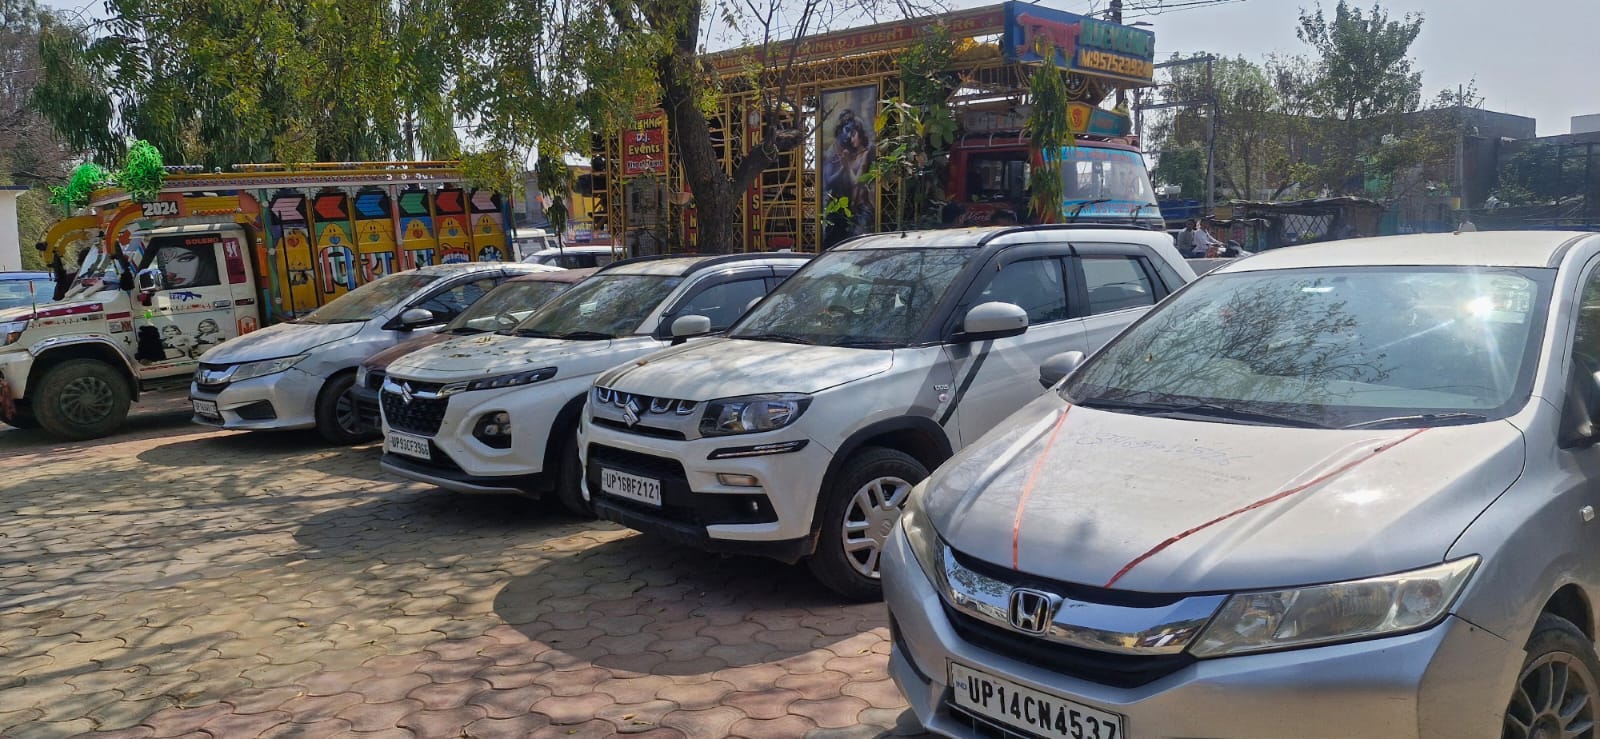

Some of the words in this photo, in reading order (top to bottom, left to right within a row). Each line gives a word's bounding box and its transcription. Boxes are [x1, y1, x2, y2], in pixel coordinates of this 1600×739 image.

[628, 144, 660, 155] Events
[142, 201, 178, 216] 2024
[185, 238, 219, 247] BOLERO
[967, 674, 1116, 739] UP14CN4537
